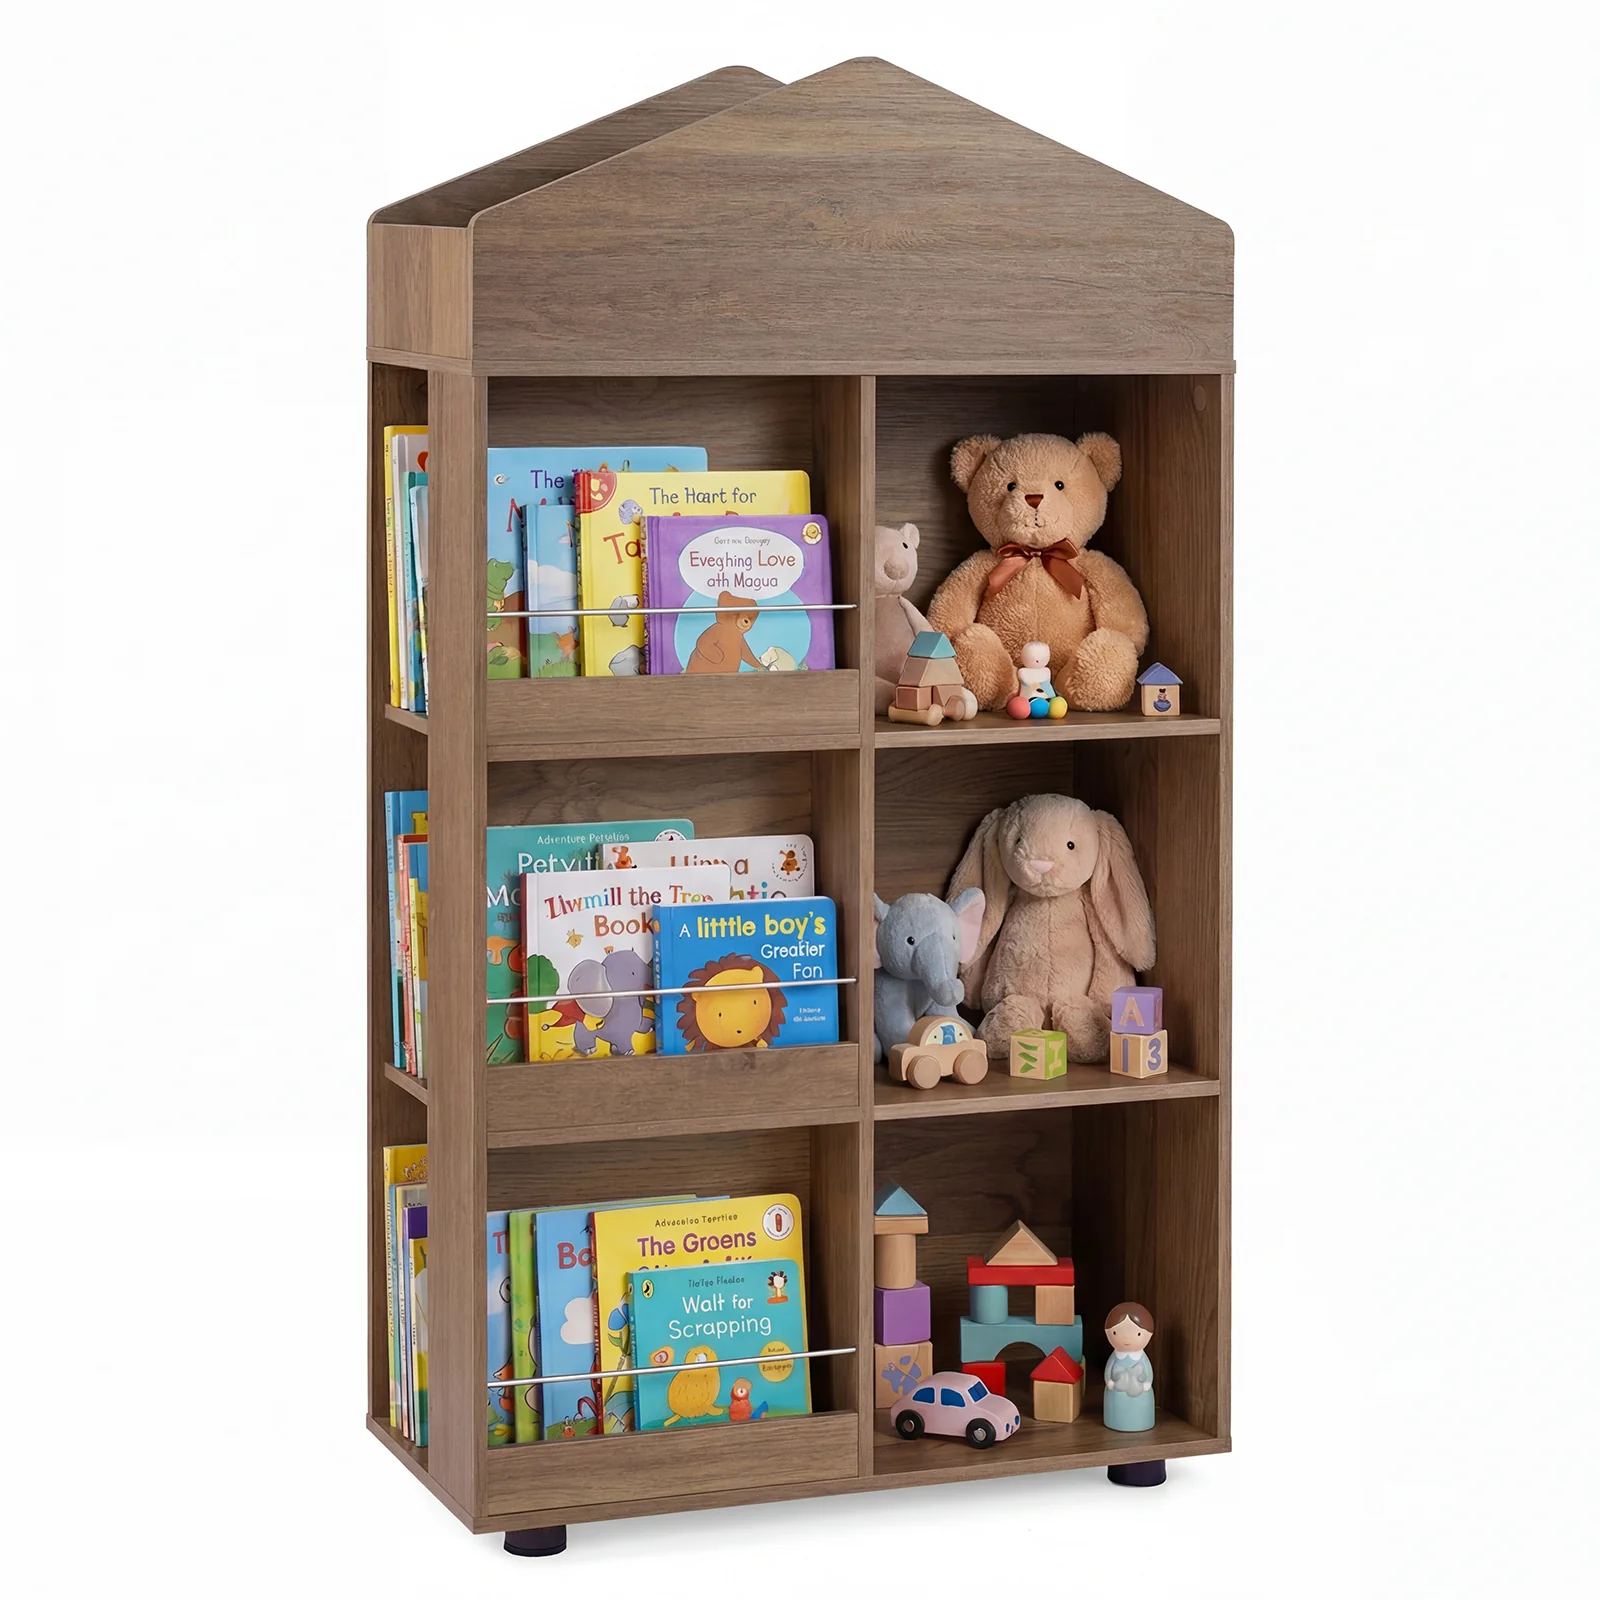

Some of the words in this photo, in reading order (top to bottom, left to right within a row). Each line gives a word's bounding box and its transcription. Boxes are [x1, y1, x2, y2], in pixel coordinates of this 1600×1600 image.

[530, 469, 565, 489] The
[649, 487, 679, 504] The
[732, 487, 757, 504] for
[689, 551, 753, 571] Eveghing
[758, 550, 796, 567] Love
[707, 572, 729, 587] ath
[734, 572, 778, 591] Magua
[628, 886, 662, 906] the
[679, 923, 691, 938] A
[765, 911, 827, 940] boy's
[793, 963, 823, 979] Fon
[1119, 996, 1145, 1027] A
[637, 1236, 676, 1257] The
[683, 1231, 757, 1253] Groens
[682, 1293, 725, 1314] Walt
[732, 1294, 754, 1309] for
[668, 1315, 772, 1339] Scrapping
